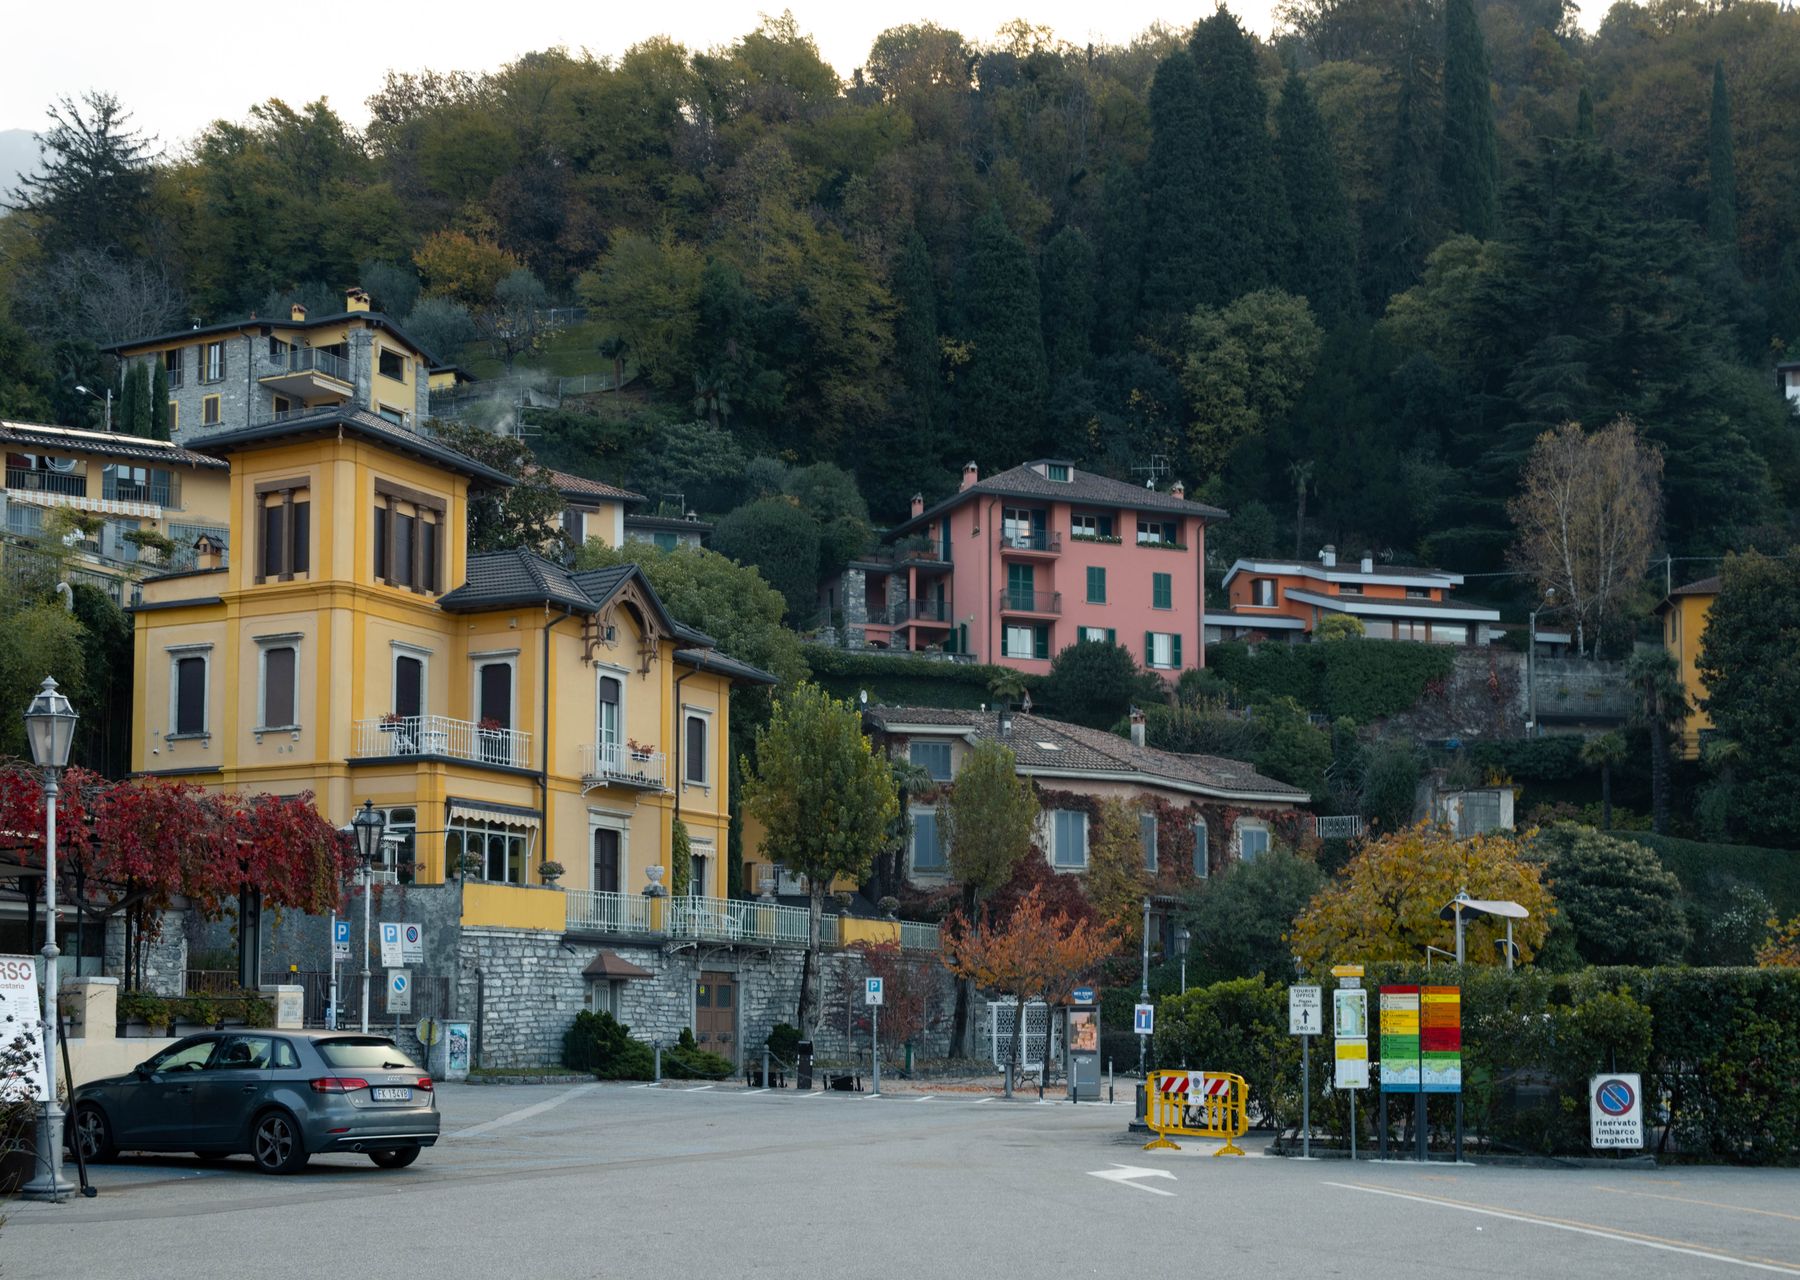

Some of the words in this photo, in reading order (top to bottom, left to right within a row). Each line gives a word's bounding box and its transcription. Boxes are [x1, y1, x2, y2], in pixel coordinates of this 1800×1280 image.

[337, 924, 347, 940] P
[386, 926, 396, 941] P
[870, 981, 878, 991] P
[1595, 1119, 1637, 1127] riservato
[1595, 1136, 1640, 1145] traghetto
